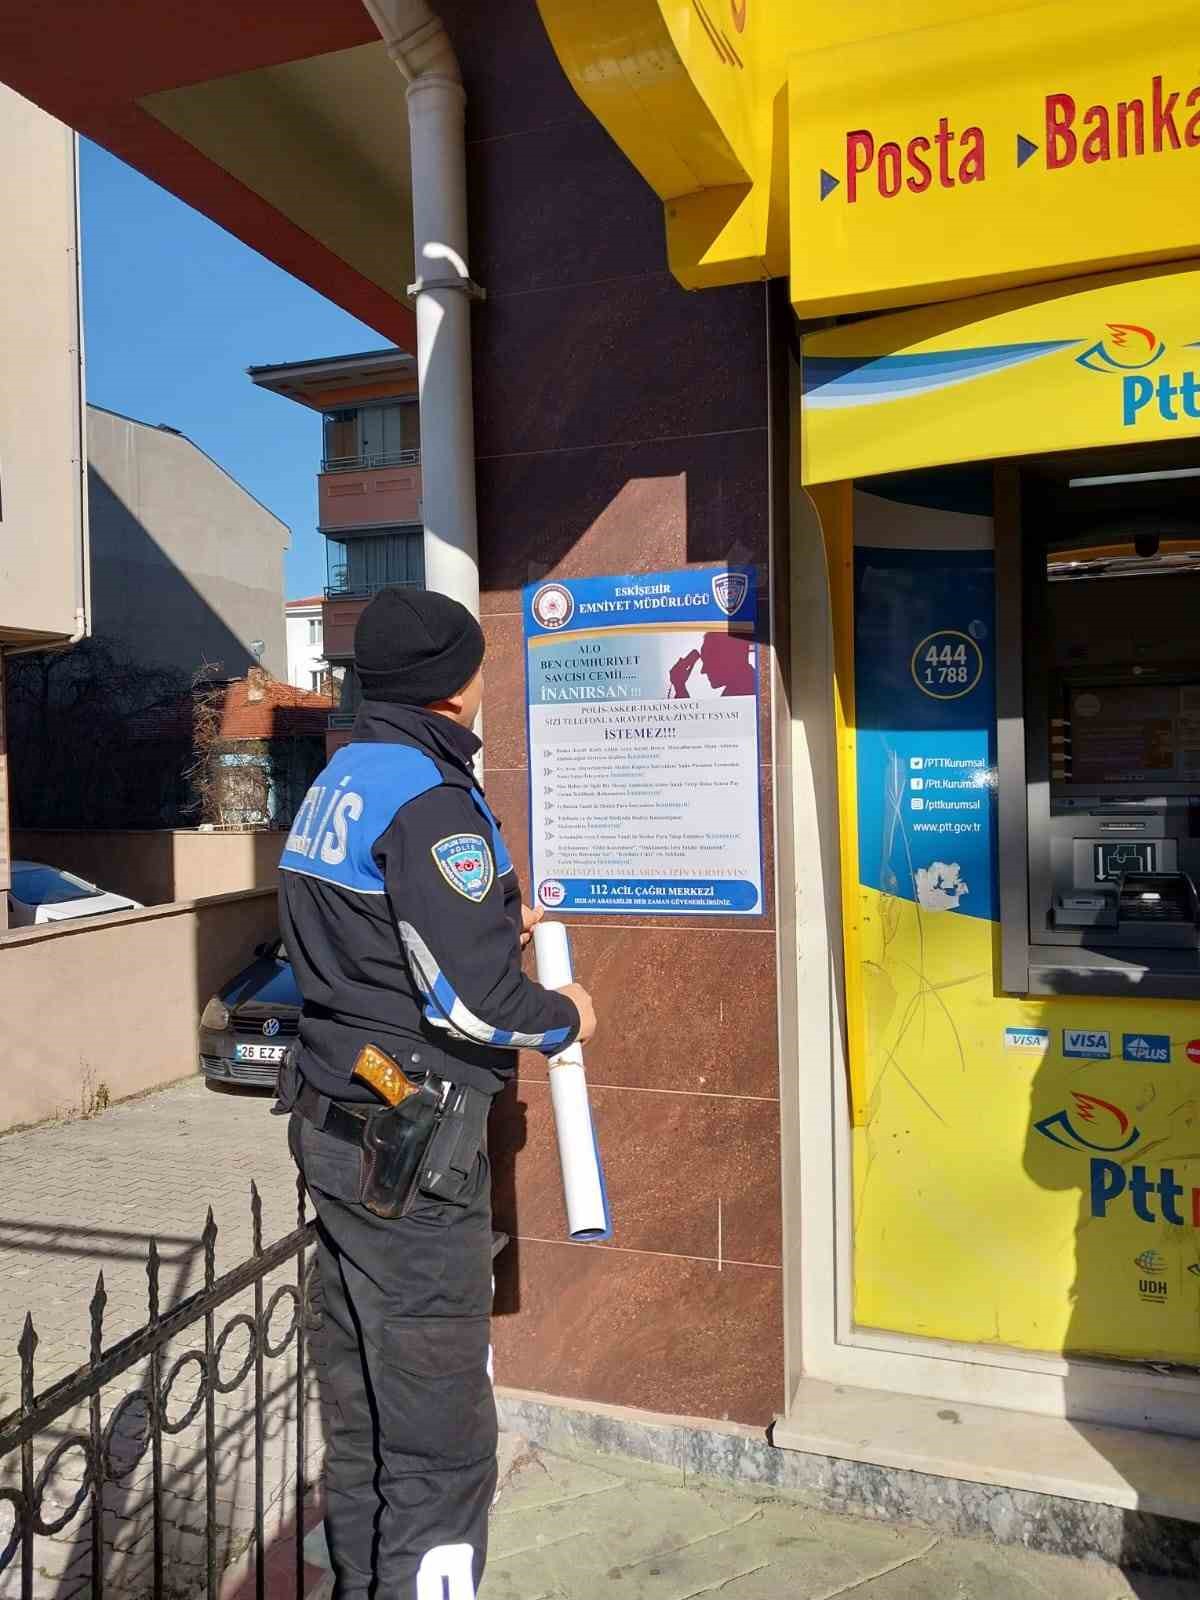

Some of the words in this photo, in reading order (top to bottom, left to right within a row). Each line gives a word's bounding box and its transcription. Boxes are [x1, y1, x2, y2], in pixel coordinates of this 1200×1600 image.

[846, 118, 986, 204] Posta
[615, 584, 672, 597] ESKİŞEHİR
[579, 599, 631, 613] EMNİYET
[633, 592, 710, 609] MÜDÜRLÜĞÜ
[579, 644, 601, 654] ALO
[926, 644, 967, 666] 444
[541, 659, 562, 669] BEN
[541, 685, 628, 700] İNANIRSAN
[913, 822, 981, 833] www.ptt.gov.tr
[544, 886, 560, 897] 112
[591, 884, 608, 895] 112
[611, 885, 633, 895] ACİL
[635, 885, 666, 896] ÇAĞRI
[668, 886, 714, 896] MERKEZİ
[1012, 1035, 1041, 1046] VISA
[1069, 1034, 1108, 1049] VISA
[241, 1046, 255, 1058] 26
[260, 1047, 276, 1059] EZ
[1136, 1047, 1168, 1061] PLUS
[1139, 1280, 1167, 1294] UDH
